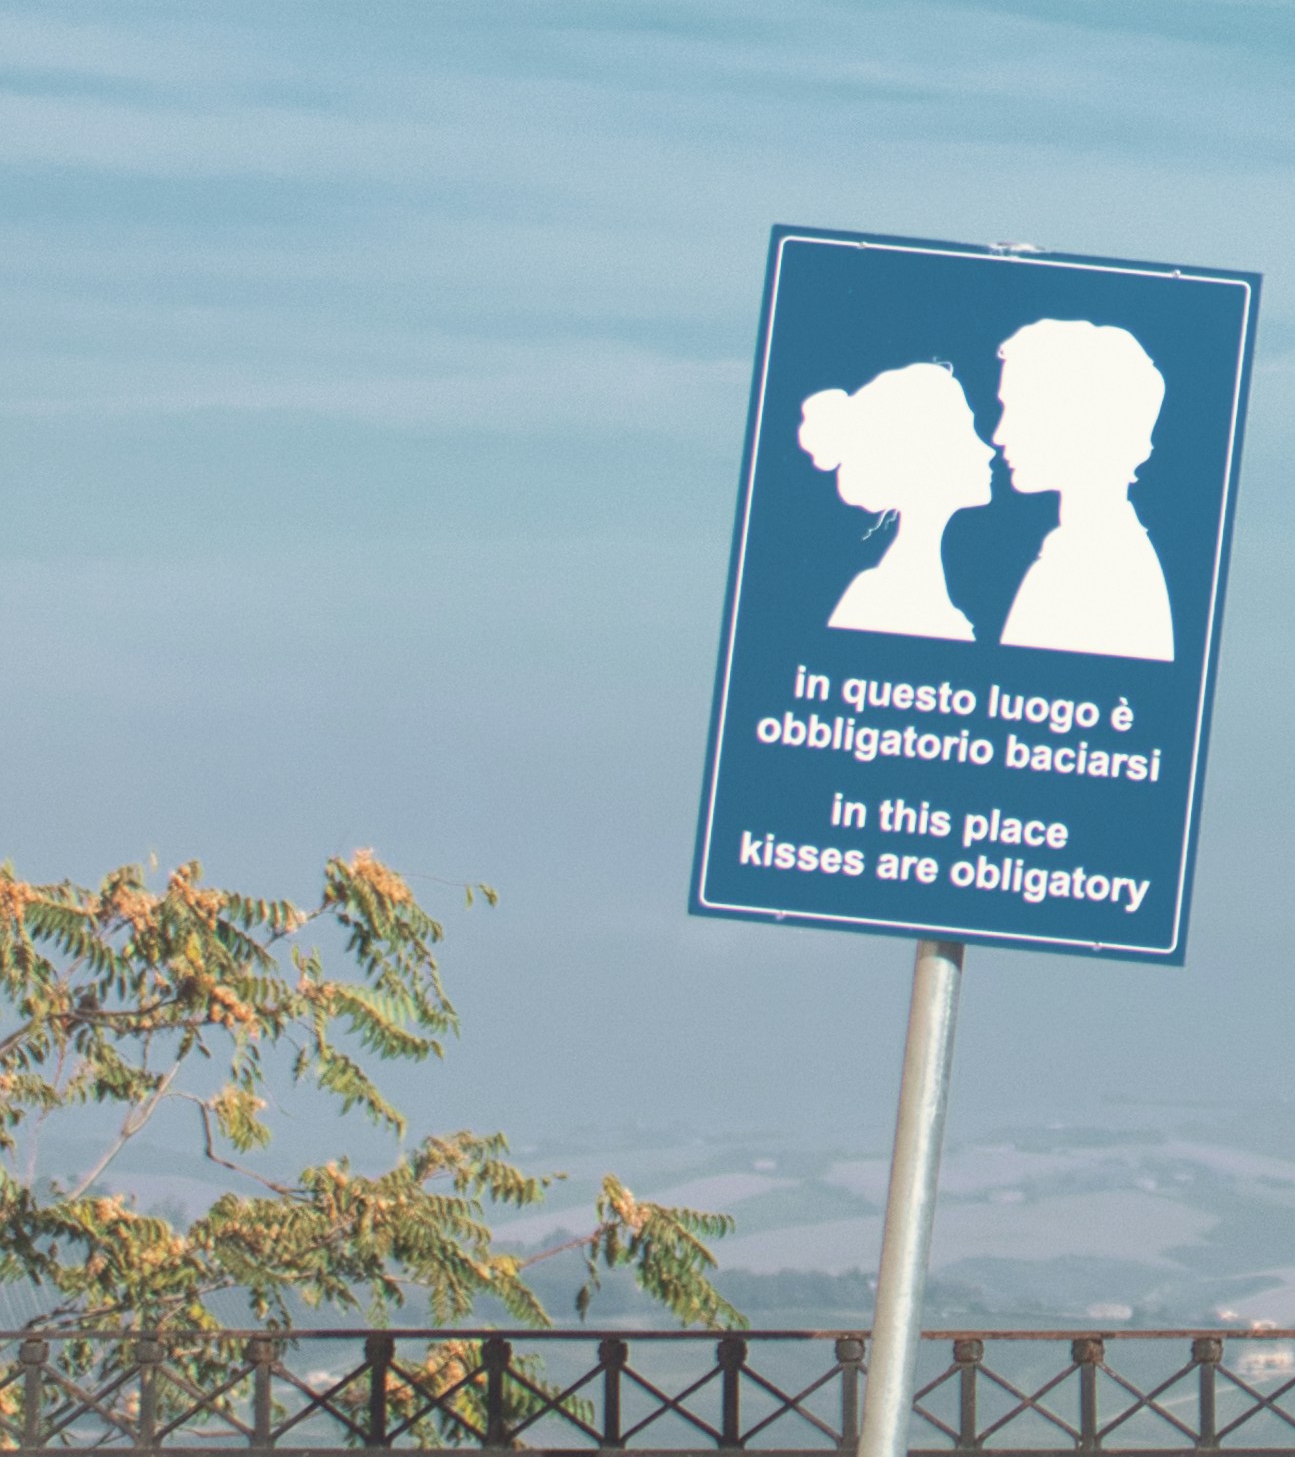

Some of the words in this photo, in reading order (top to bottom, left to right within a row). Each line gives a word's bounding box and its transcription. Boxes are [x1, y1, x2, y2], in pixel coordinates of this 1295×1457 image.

[795, 665, 829, 701] in
[842, 679, 976, 715] questo
[988, 685, 1099, 733] luogo
[1111, 697, 1133, 731] è
[757, 712, 993, 765] obbligatorio
[1006, 734, 1160, 781] baciarsi
[832, 793, 866, 828] in
[879, 799, 950, 837] this
[963, 809, 1068, 849] place
[740, 831, 864, 876] kisses
[876, 854, 938, 883] are
[950, 856, 1150, 912] obligatory
